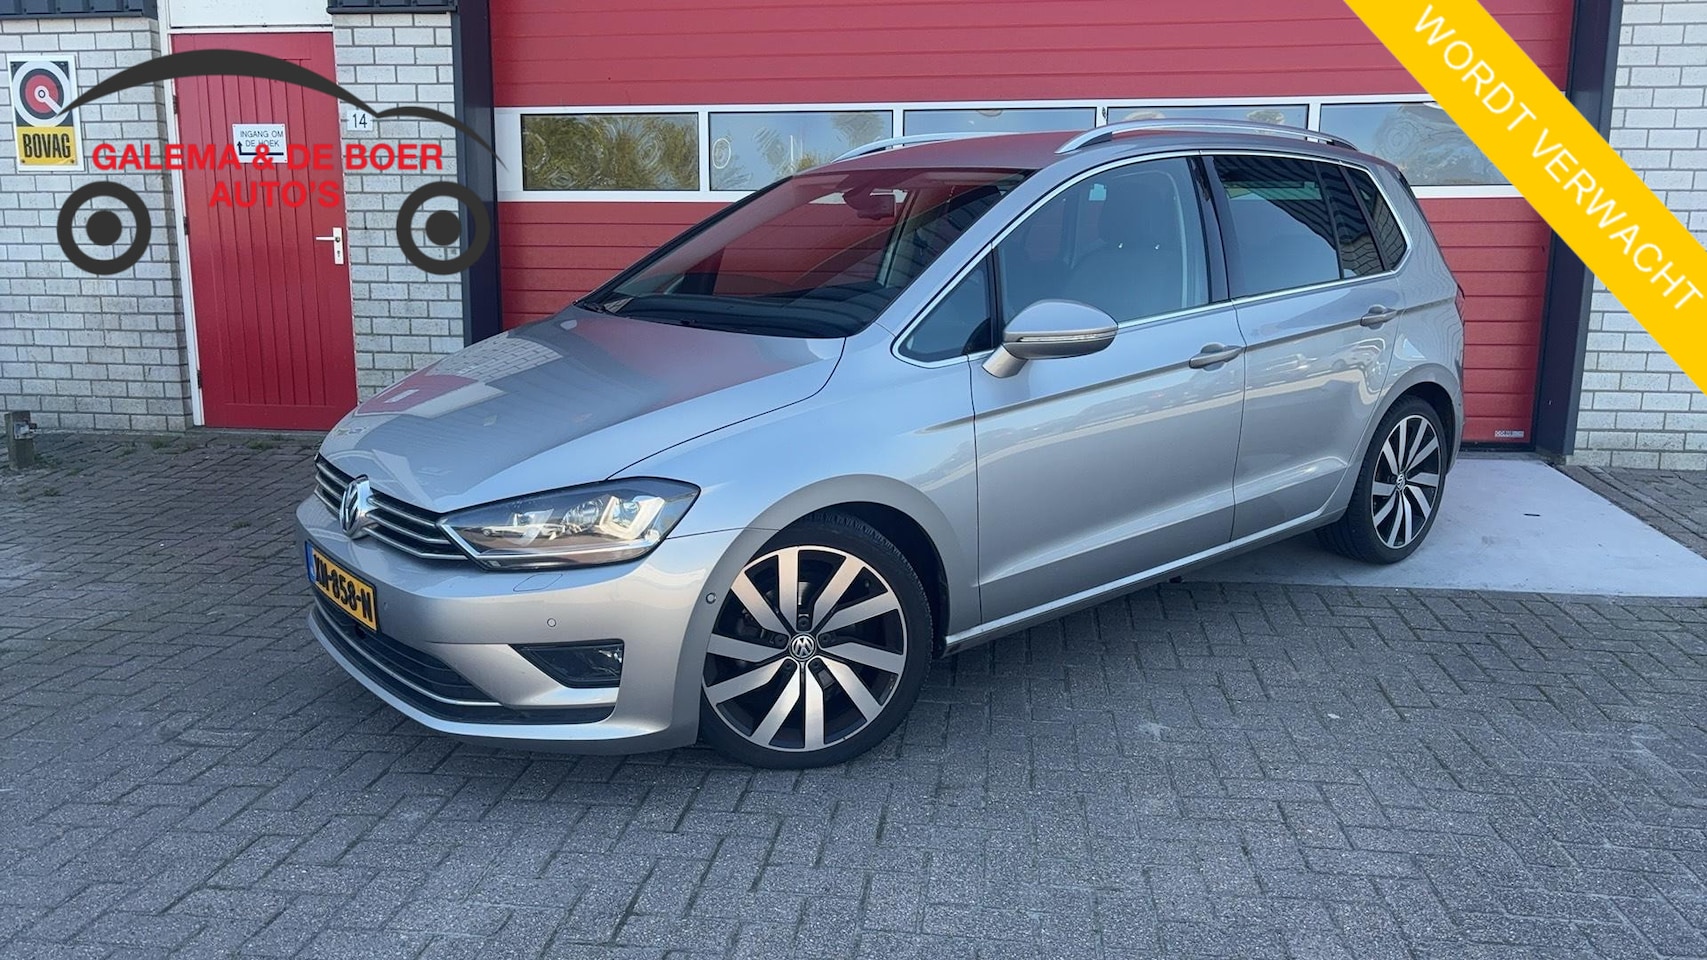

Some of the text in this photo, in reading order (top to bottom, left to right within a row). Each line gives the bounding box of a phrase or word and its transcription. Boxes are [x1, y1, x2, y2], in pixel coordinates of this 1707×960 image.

[352, 112, 367, 128] 14
[240, 130, 268, 138] INGANG
[22, 132, 71, 159] BOVAG
[245, 139, 255, 147] DE
[313, 553, 373, 623] XN-858-N
